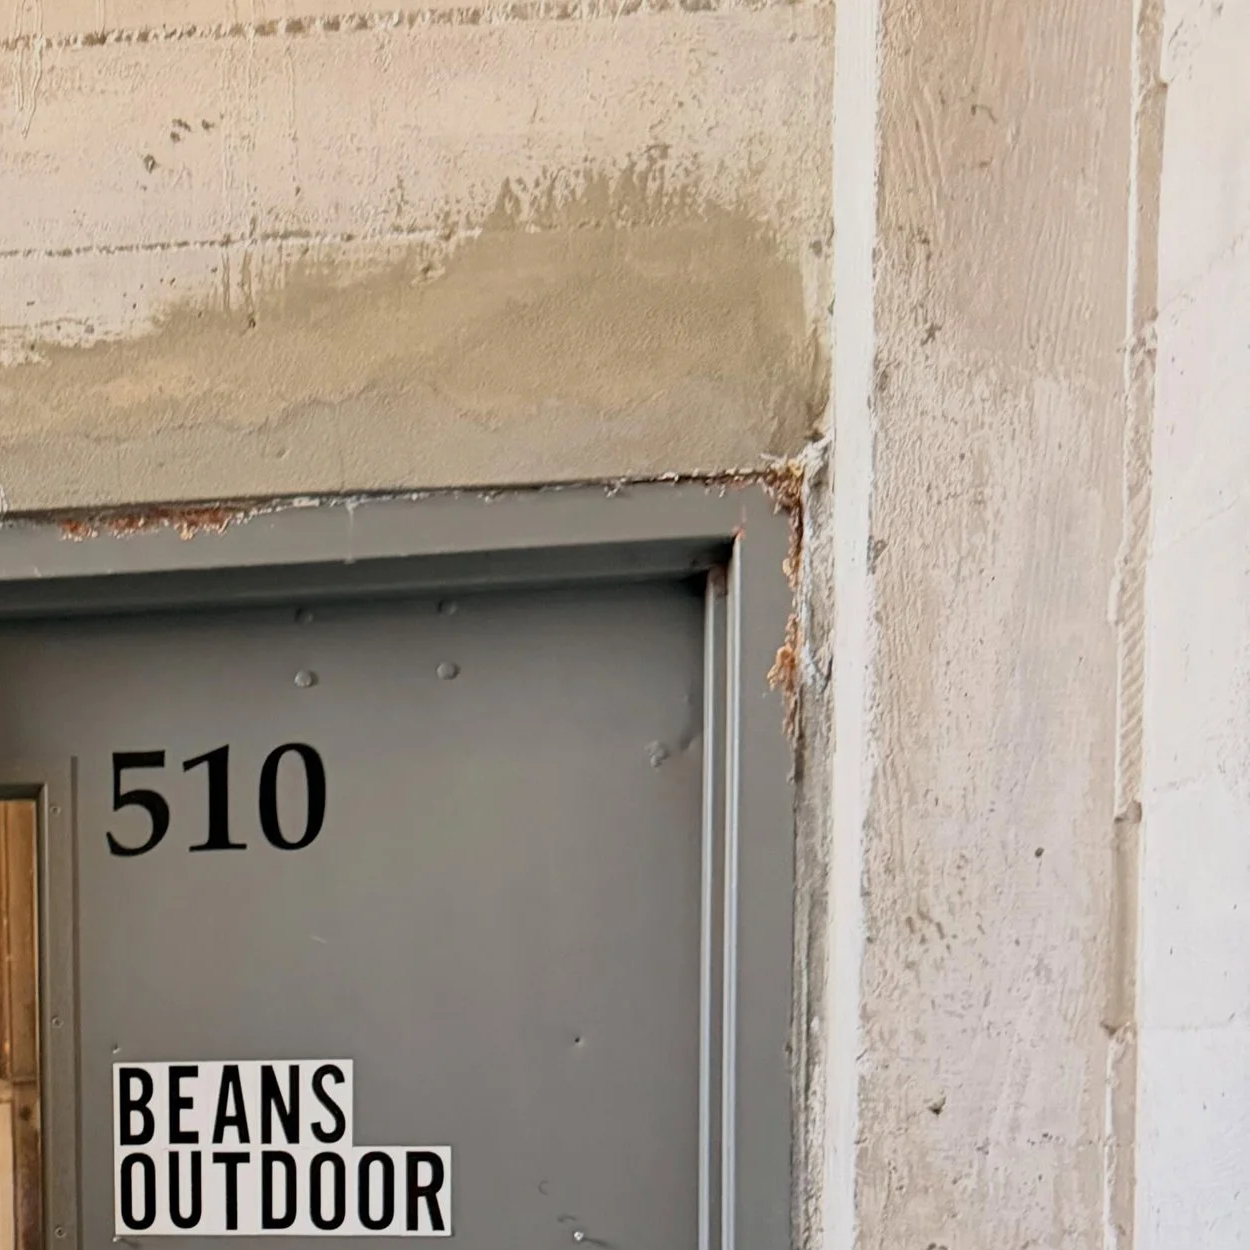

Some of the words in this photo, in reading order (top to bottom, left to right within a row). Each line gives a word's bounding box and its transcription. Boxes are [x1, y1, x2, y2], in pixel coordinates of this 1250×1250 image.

[106, 742, 326, 857] 510
[118, 1064, 347, 1146] BEANS
[120, 1150, 446, 1231] OUTDOOR
